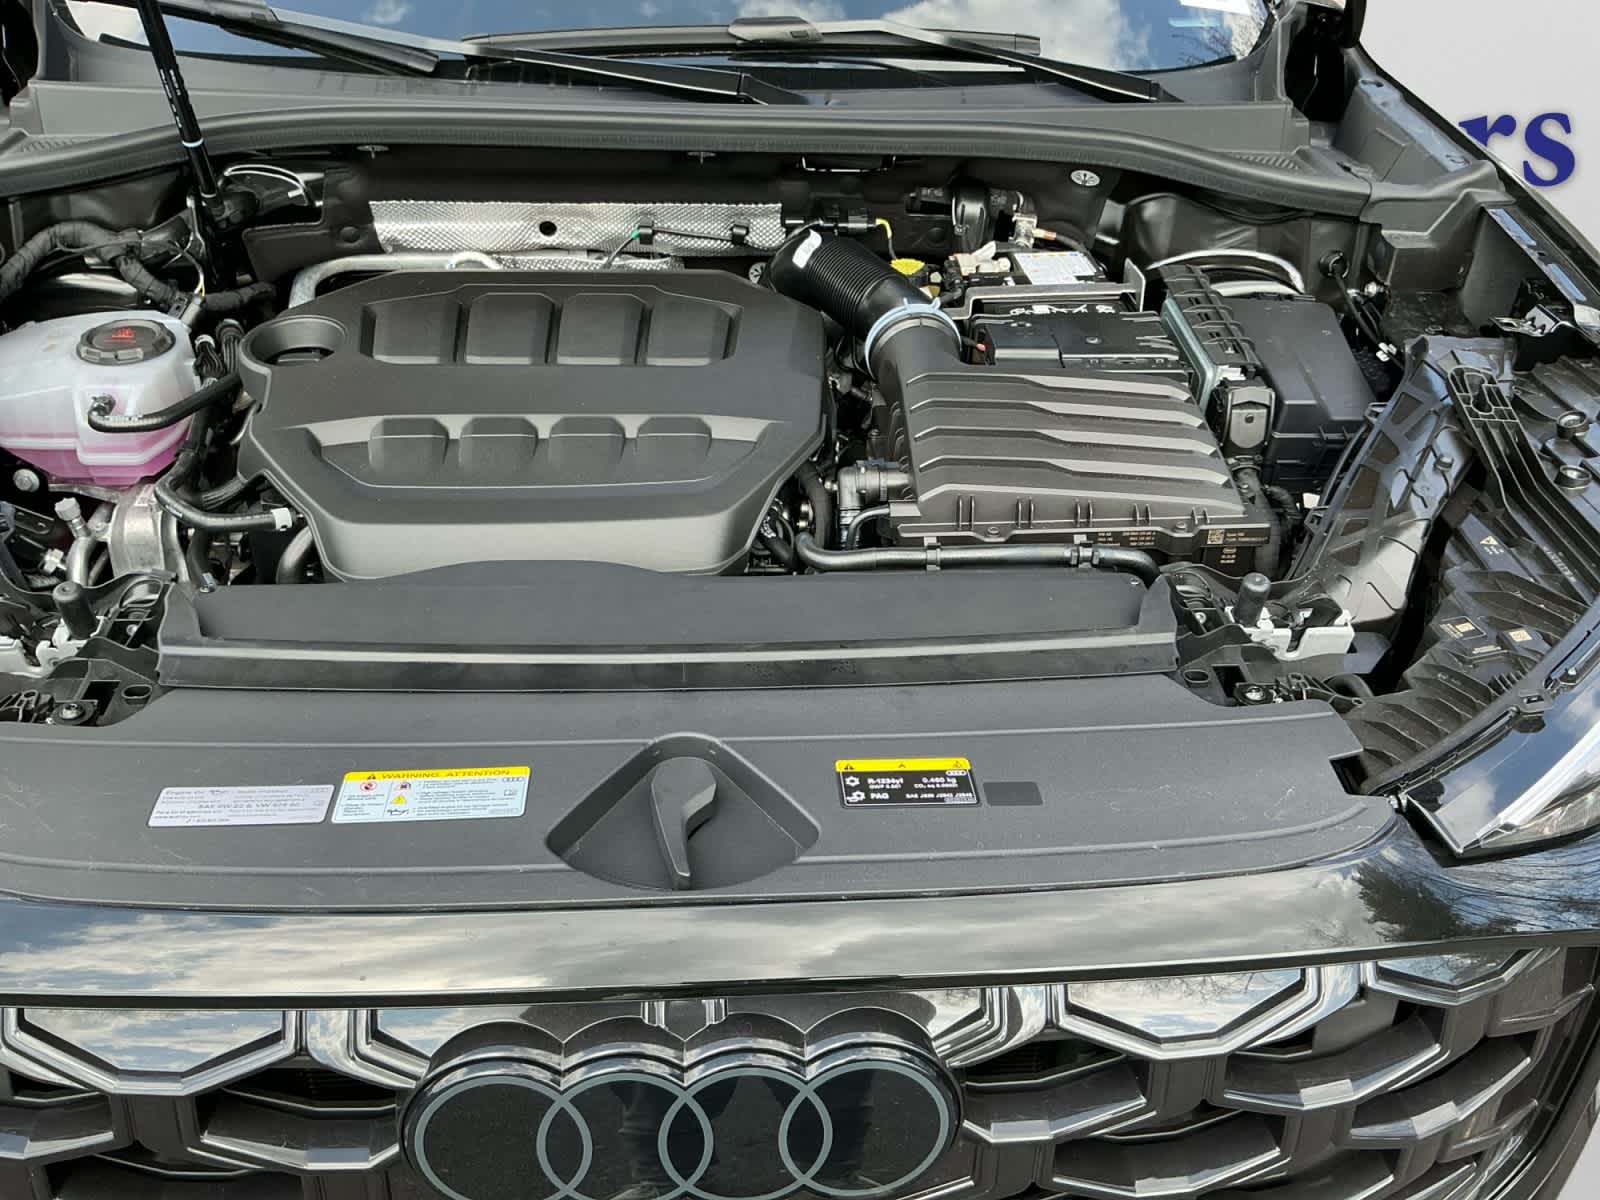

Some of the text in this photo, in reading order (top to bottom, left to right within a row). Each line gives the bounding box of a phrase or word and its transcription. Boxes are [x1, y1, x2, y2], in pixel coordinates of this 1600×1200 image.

[382, 769, 512, 780] WARNING ATTENTION
[870, 792, 890, 800] PAG
